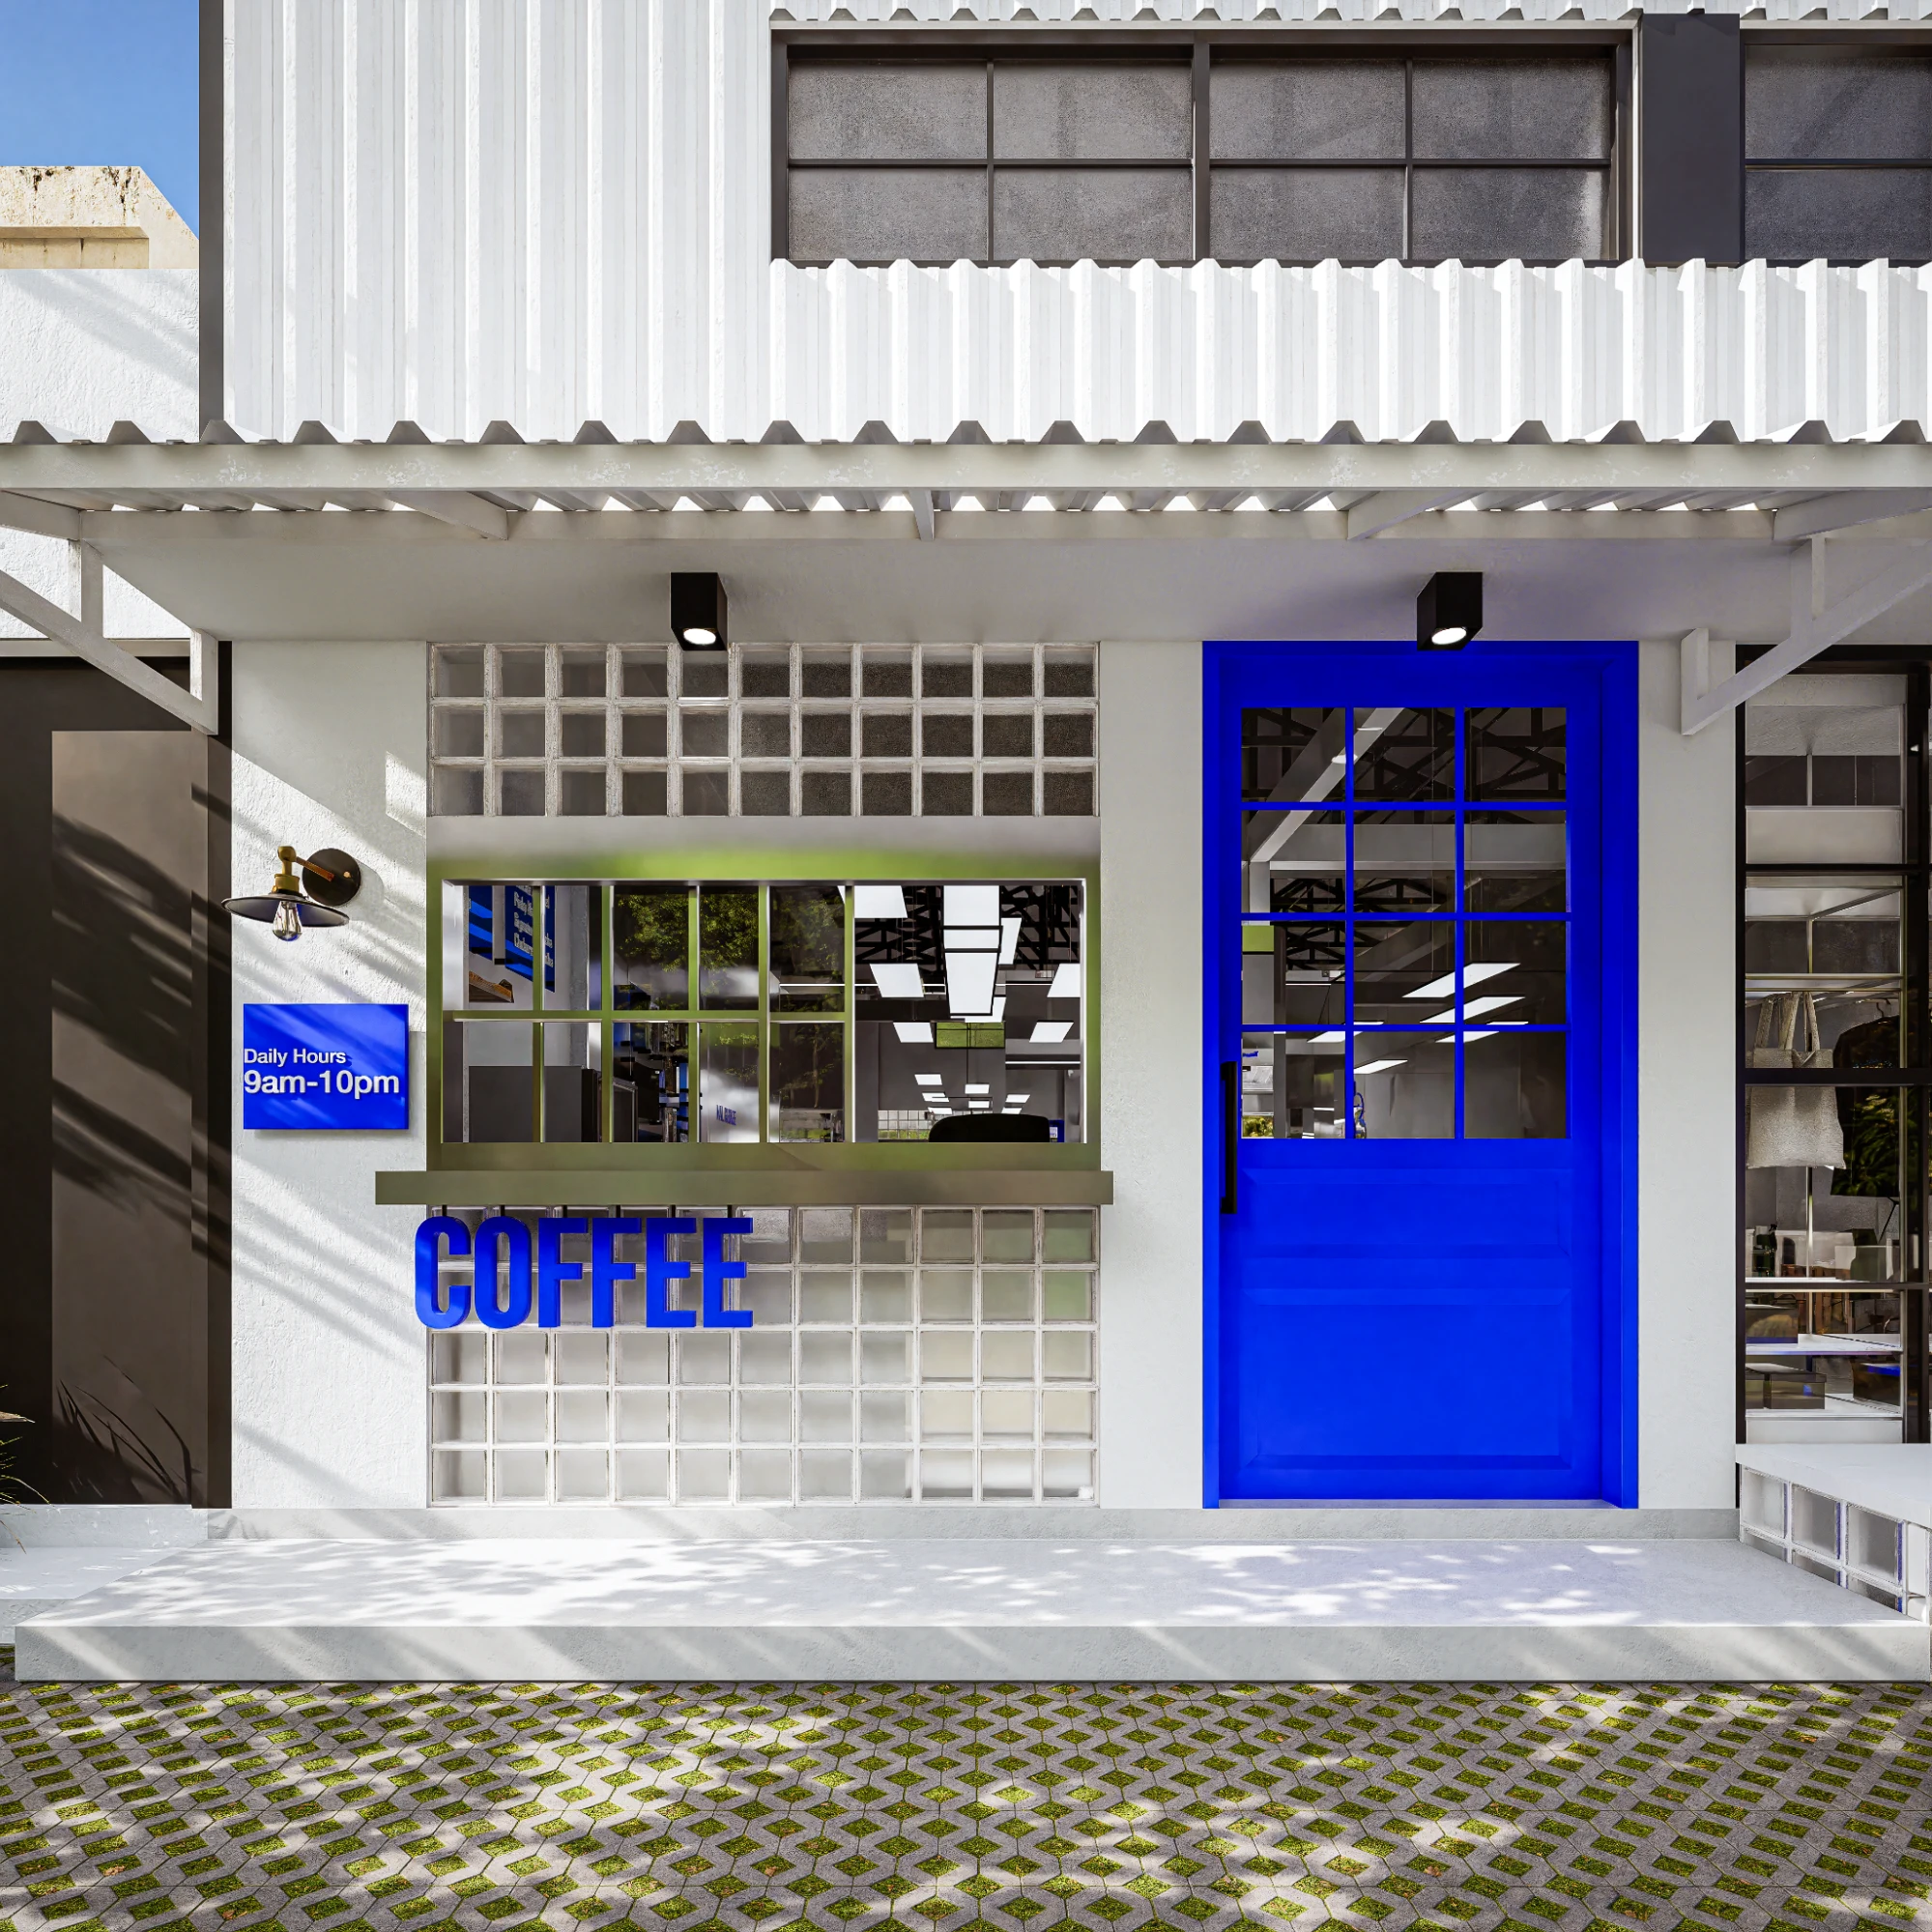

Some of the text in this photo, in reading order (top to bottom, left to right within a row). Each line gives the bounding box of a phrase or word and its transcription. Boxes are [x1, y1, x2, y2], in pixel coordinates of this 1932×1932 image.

[244, 1048, 347, 1067] Daily Hours
[244, 1069, 399, 1100] 9am-10pm
[415, 1216, 754, 1329] COFFEE
